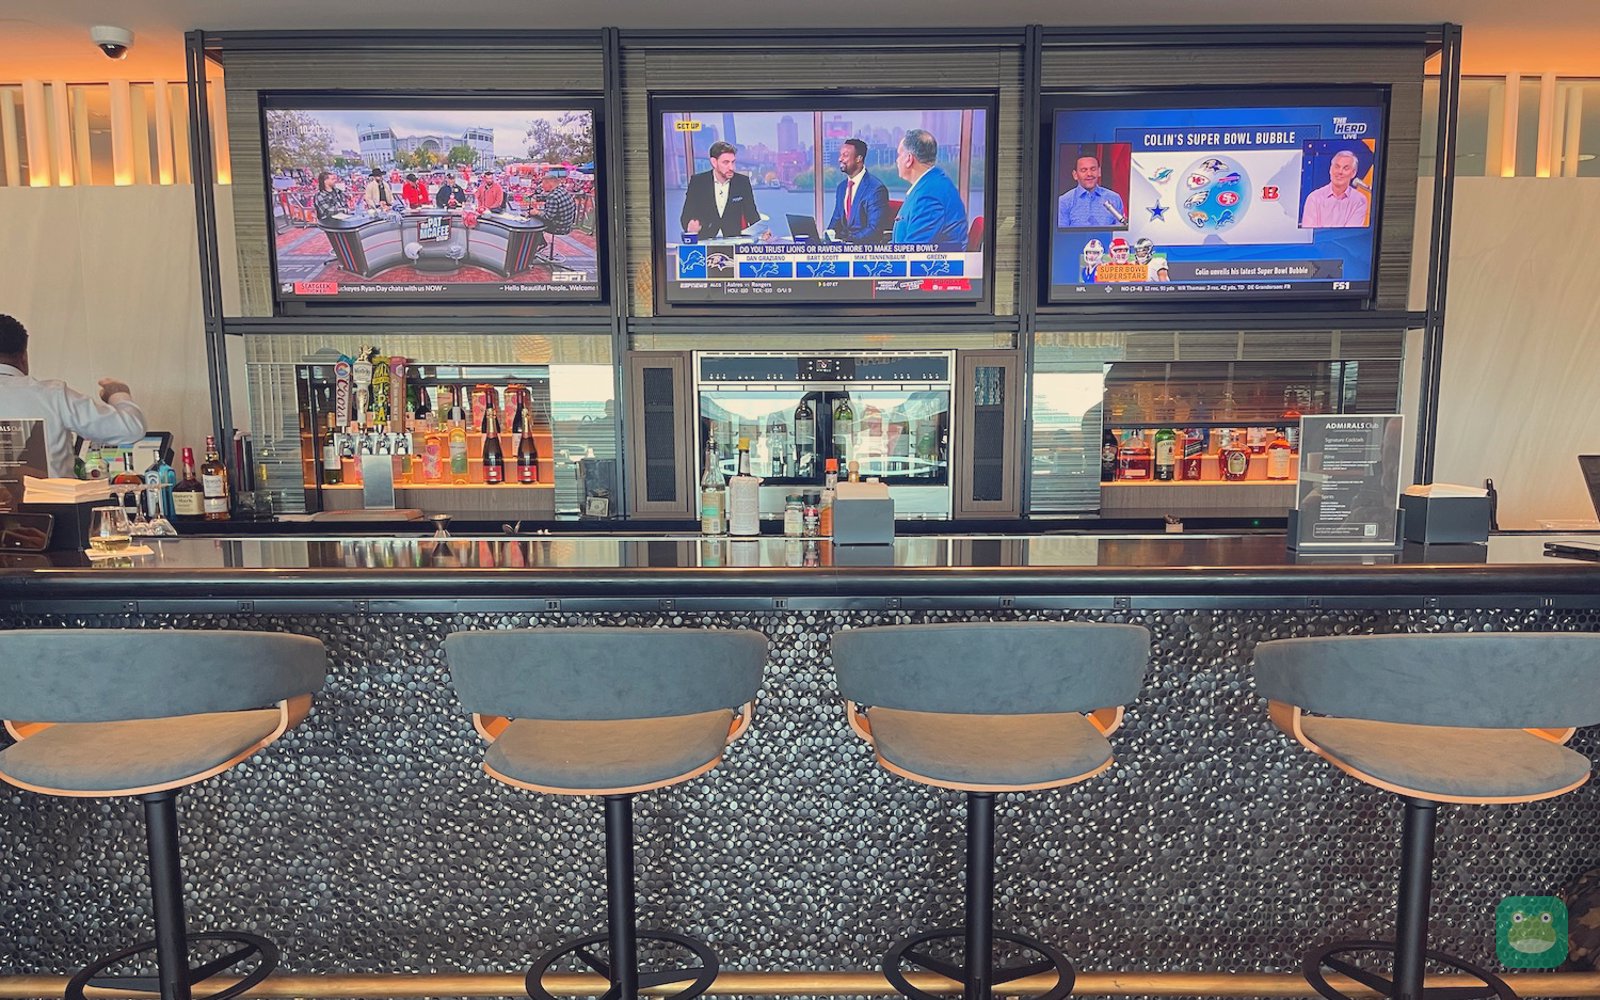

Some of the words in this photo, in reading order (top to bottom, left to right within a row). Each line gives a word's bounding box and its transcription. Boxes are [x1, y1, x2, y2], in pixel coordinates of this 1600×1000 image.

[1336, 124, 1365, 133] HERD
[1144, 134, 1184, 146] COLIN'S
[1187, 133, 1220, 145] SUPER
[1224, 133, 1252, 145] BOWL
[1255, 132, 1295, 144] BUBBLE
[428, 216, 442, 228] PAT
[420, 225, 449, 239] MCAFEE
[817, 245, 842, 253] RAVENS
[1240, 267, 1256, 275] latest
[1257, 267, 1272, 275] Super
[1289, 266, 1308, 274] Bubble
[552, 272, 586, 281] ESPN
[360, 285, 376, 293] Ryan
[376, 285, 388, 293] Day
[1333, 281, 1350, 289] FS1
